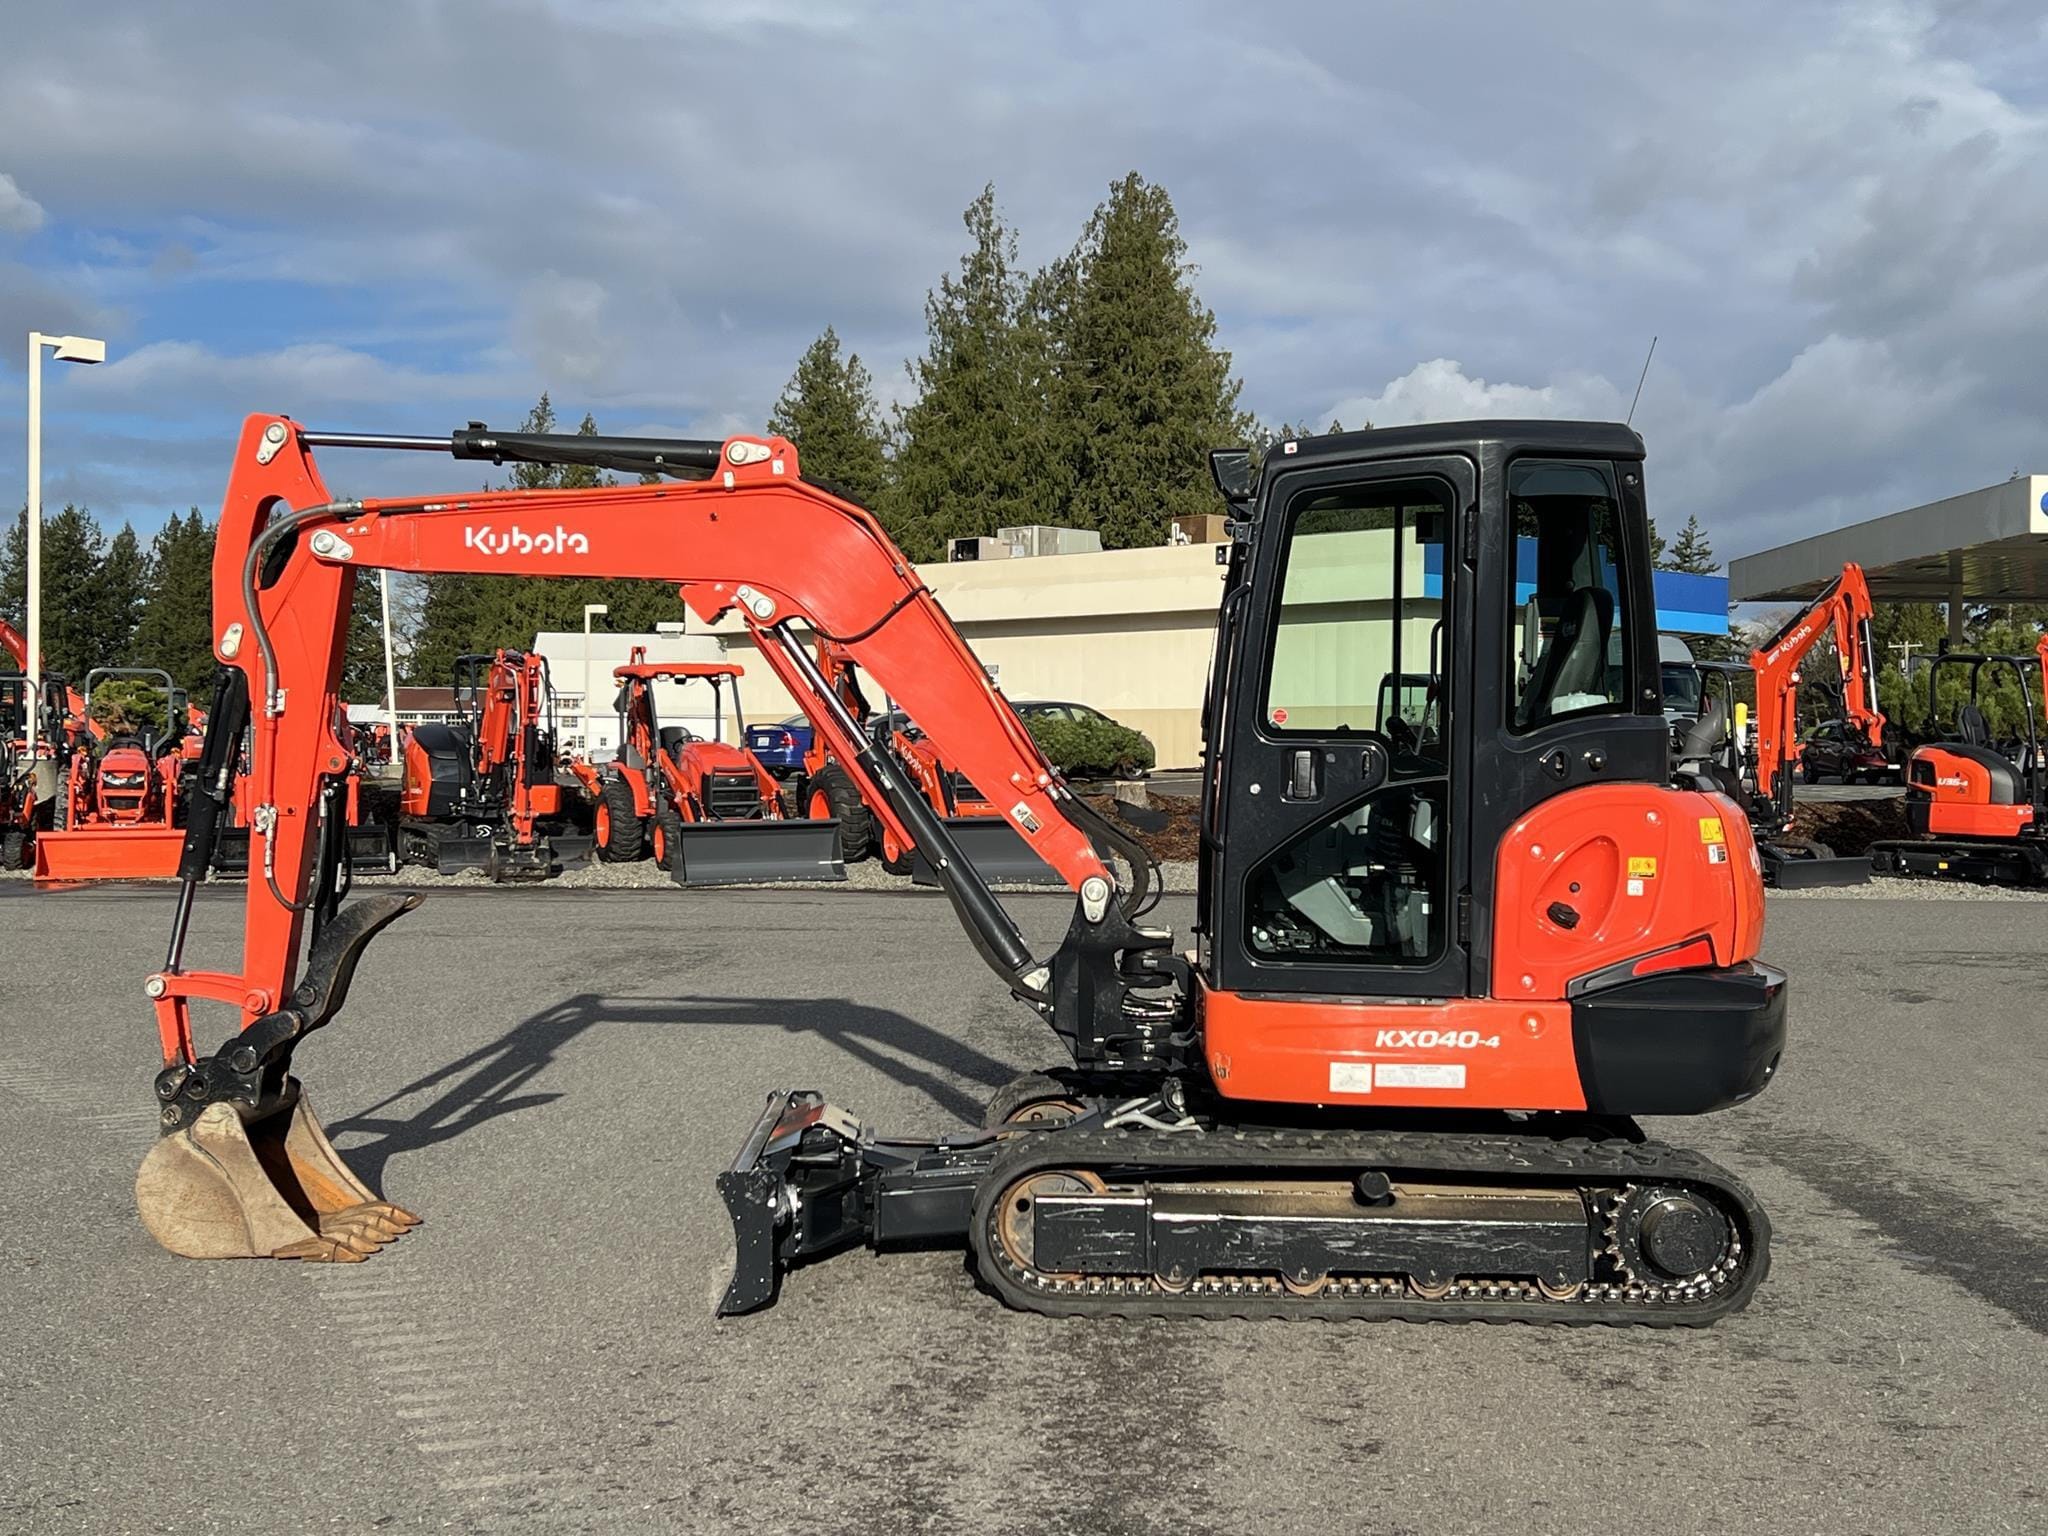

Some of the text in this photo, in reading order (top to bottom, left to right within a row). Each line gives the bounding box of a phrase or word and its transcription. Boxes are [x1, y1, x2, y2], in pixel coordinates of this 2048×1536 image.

[464, 525, 590, 555] Kubota
[1780, 625, 1812, 653] Kubota
[1374, 1030, 1500, 1049] KX040-4
